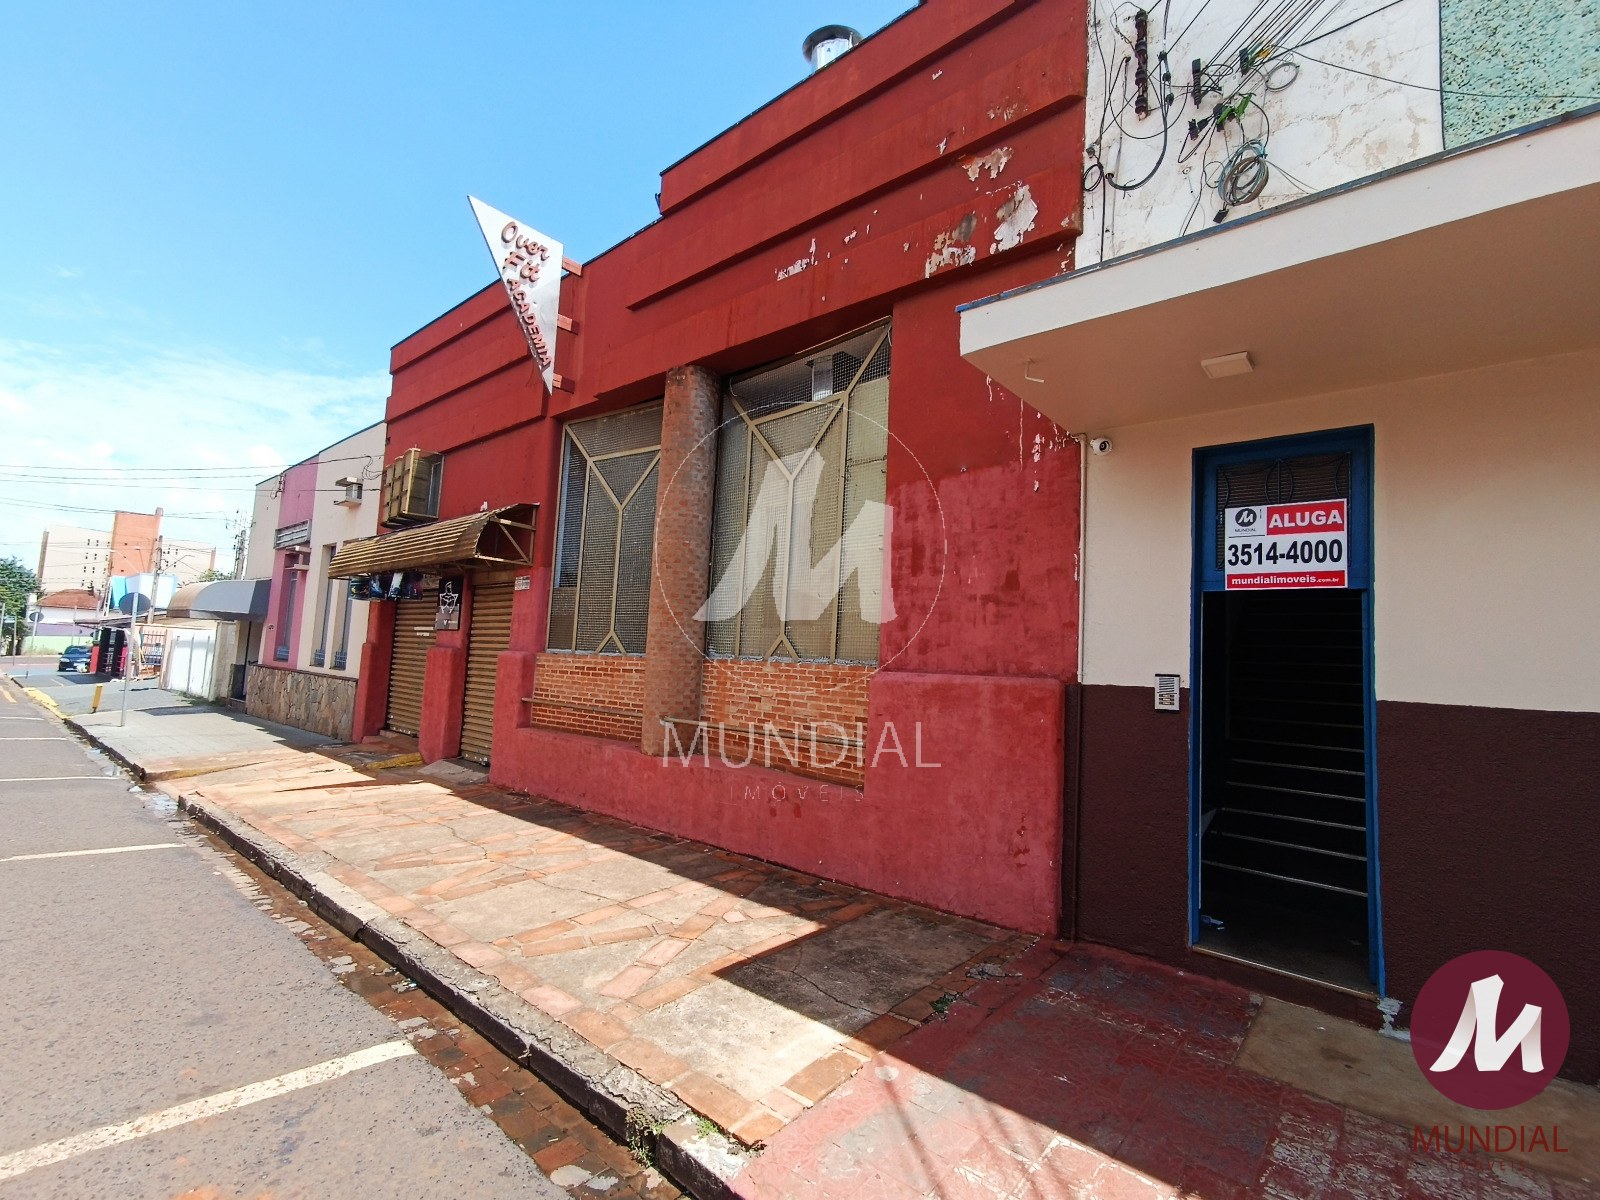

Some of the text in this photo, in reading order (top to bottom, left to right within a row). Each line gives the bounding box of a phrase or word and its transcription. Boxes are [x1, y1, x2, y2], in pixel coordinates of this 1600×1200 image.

[507, 278, 552, 368] ACADEMIA
[1268, 509, 1343, 529] ALUGA
[1227, 539, 1343, 567] 3514-4000
[1231, 574, 1339, 585] mundialimoveis.com.br
